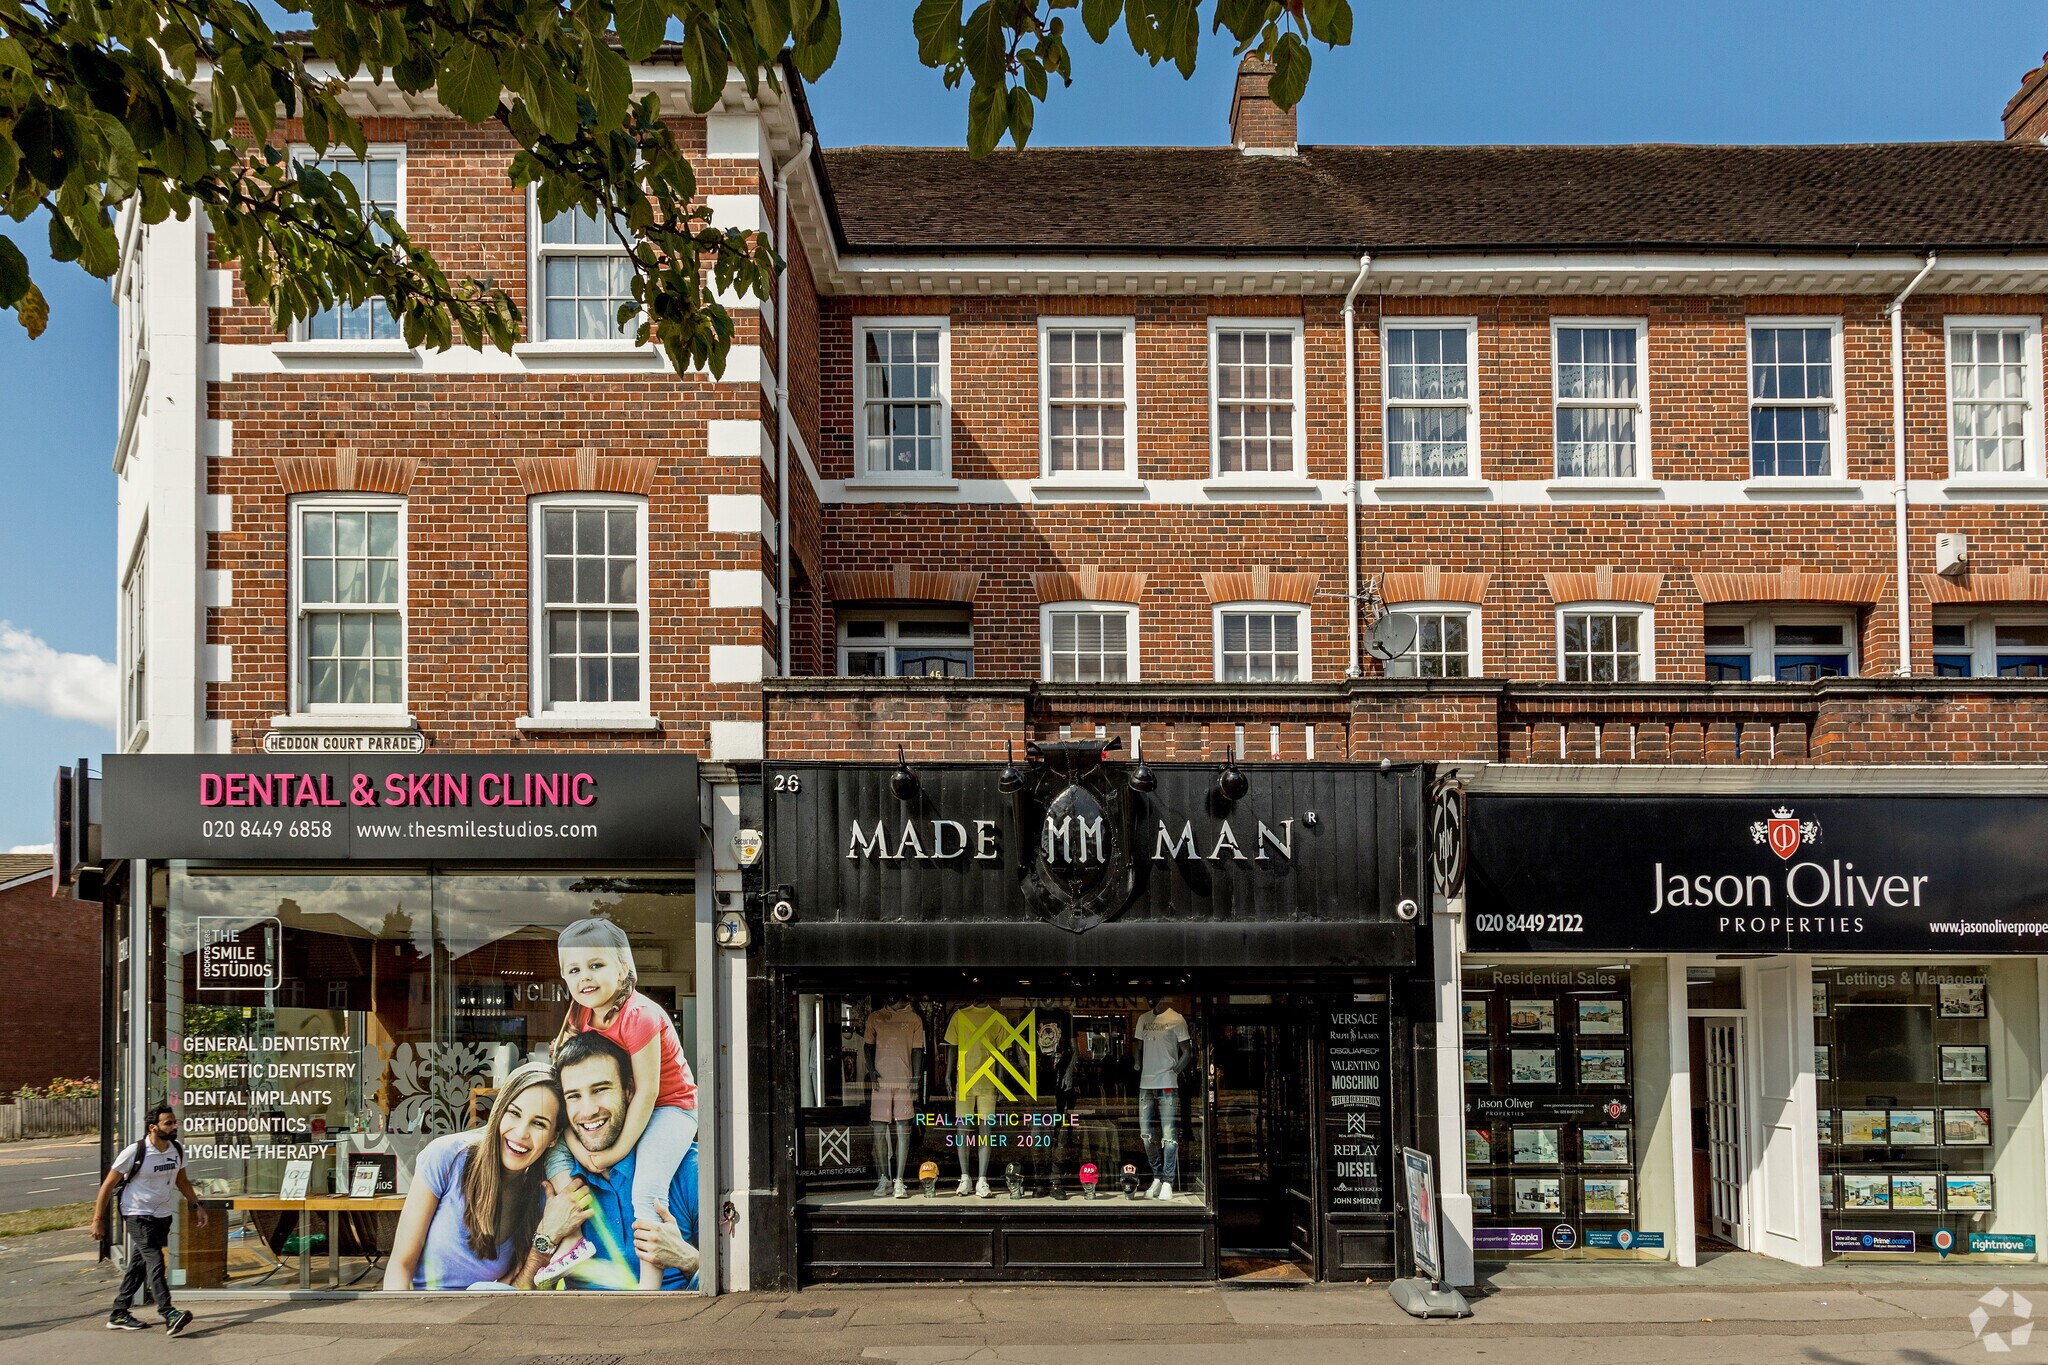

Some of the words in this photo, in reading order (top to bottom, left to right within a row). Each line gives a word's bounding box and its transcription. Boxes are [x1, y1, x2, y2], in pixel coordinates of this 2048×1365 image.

[271, 737, 319, 749] HEDDON
[323, 737, 364, 749] COURT
[368, 737, 417, 749] PARADE
[200, 773, 346, 807] DENTAL
[351, 773, 377, 807] &
[385, 773, 471, 807] SKIN
[479, 773, 598, 807] CLINIC
[773, 775, 800, 792] 26
[202, 821, 236, 839] 020
[240, 821, 285, 839] 8449
[289, 821, 332, 839] 6858
[357, 820, 598, 839] www.thesmilestudios.com
[846, 820, 998, 861] MADE
[1151, 819, 1294, 861] MAN
[1650, 862, 1771, 914] Jason
[1786, 859, 1928, 907] Oliver
[1476, 913, 1503, 932] 020
[1506, 913, 1545, 932] 8449
[1547, 913, 1583, 932] 2122
[1720, 917, 1864, 933] PROPERTIES
[211, 929, 240, 943] THE
[203, 929, 211, 977] COCKFOSTERS
[211, 946, 256, 960] SMILE
[211, 960, 272, 977] STÜDIOS
[1492, 971, 1573, 985] Residential
[1577, 971, 1616, 985] Sales
[1836, 971, 1896, 987] Lettings
[1901, 971, 1911, 985] &
[1331, 1013, 1378, 1024] VERSACE
[183, 1037, 258, 1052] GENERAL
[262, 1036, 350, 1051] DENTISTRY
[183, 1064, 263, 1079] COSMETIC
[268, 1063, 356, 1078] DENTISTRY
[1331, 1060, 1380, 1070] VALENTINO
[1331, 1075, 1379, 1090] MOSCHINO
[183, 1091, 247, 1106] DENTAL
[251, 1090, 332, 1105] IMPLANTS
[1477, 1098, 1503, 1109] Jason
[1504, 1098, 1534, 1108] Oliver
[183, 1117, 307, 1132] ORTHODONTICS
[915, 1113, 952, 1126] REAL
[955, 1113, 1020, 1126] ARTISTIC
[1023, 1113, 1080, 1126] PEOPLE
[945, 1135, 1008, 1147] SUMMER
[1017, 1135, 1051, 1147] 2020
[184, 1145, 251, 1160] HYGIENE
[257, 1144, 328, 1159] THERAPY
[1334, 1144, 1380, 1155] REPLAY
[1337, 1162, 1377, 1177] DIESEL
[1511, 1233, 1538, 1242] Zoopla
[1972, 1240, 2024, 1251] rightmove
